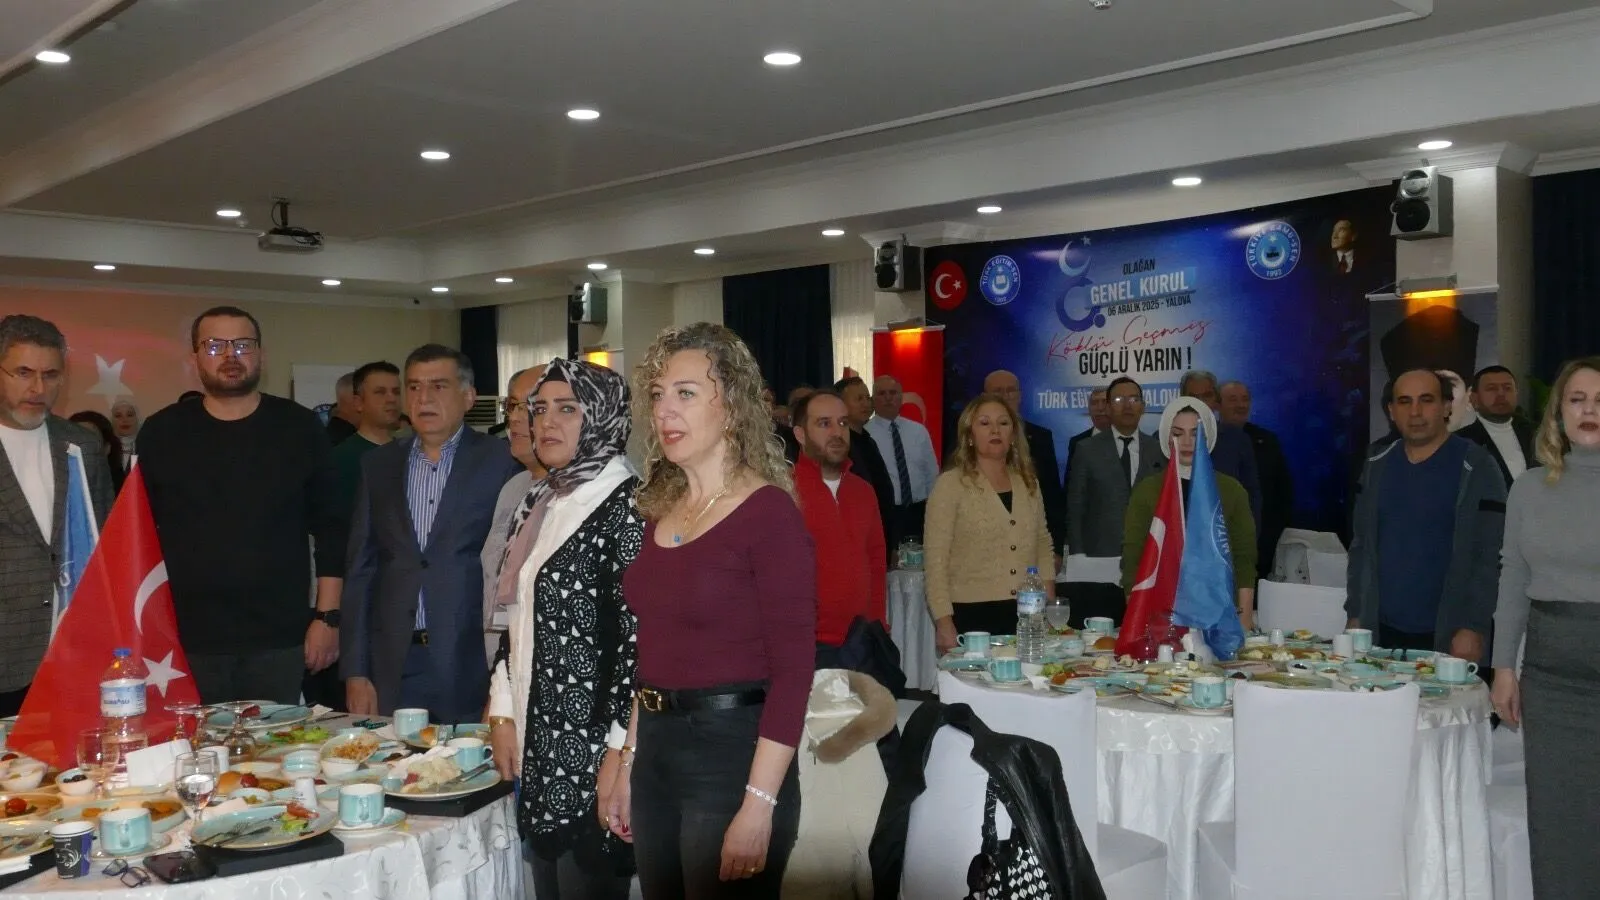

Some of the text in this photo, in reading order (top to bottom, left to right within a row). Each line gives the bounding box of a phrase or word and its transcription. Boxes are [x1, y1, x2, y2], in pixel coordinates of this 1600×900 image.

[1122, 257, 1156, 275] OLAĞAN
[1090, 271, 1189, 305] GENEL KURUL
[1107, 306, 1117, 316] 06
[1117, 302, 1141, 315] ARALIK
[1142, 300, 1160, 312] 2025
[1166, 294, 1192, 308] YALOVA
[1079, 346, 1192, 378] GÜÇLÜ YARIN !
[1037, 389, 1068, 409] TÜRK
[1071, 387, 1092, 409] EĞİ
